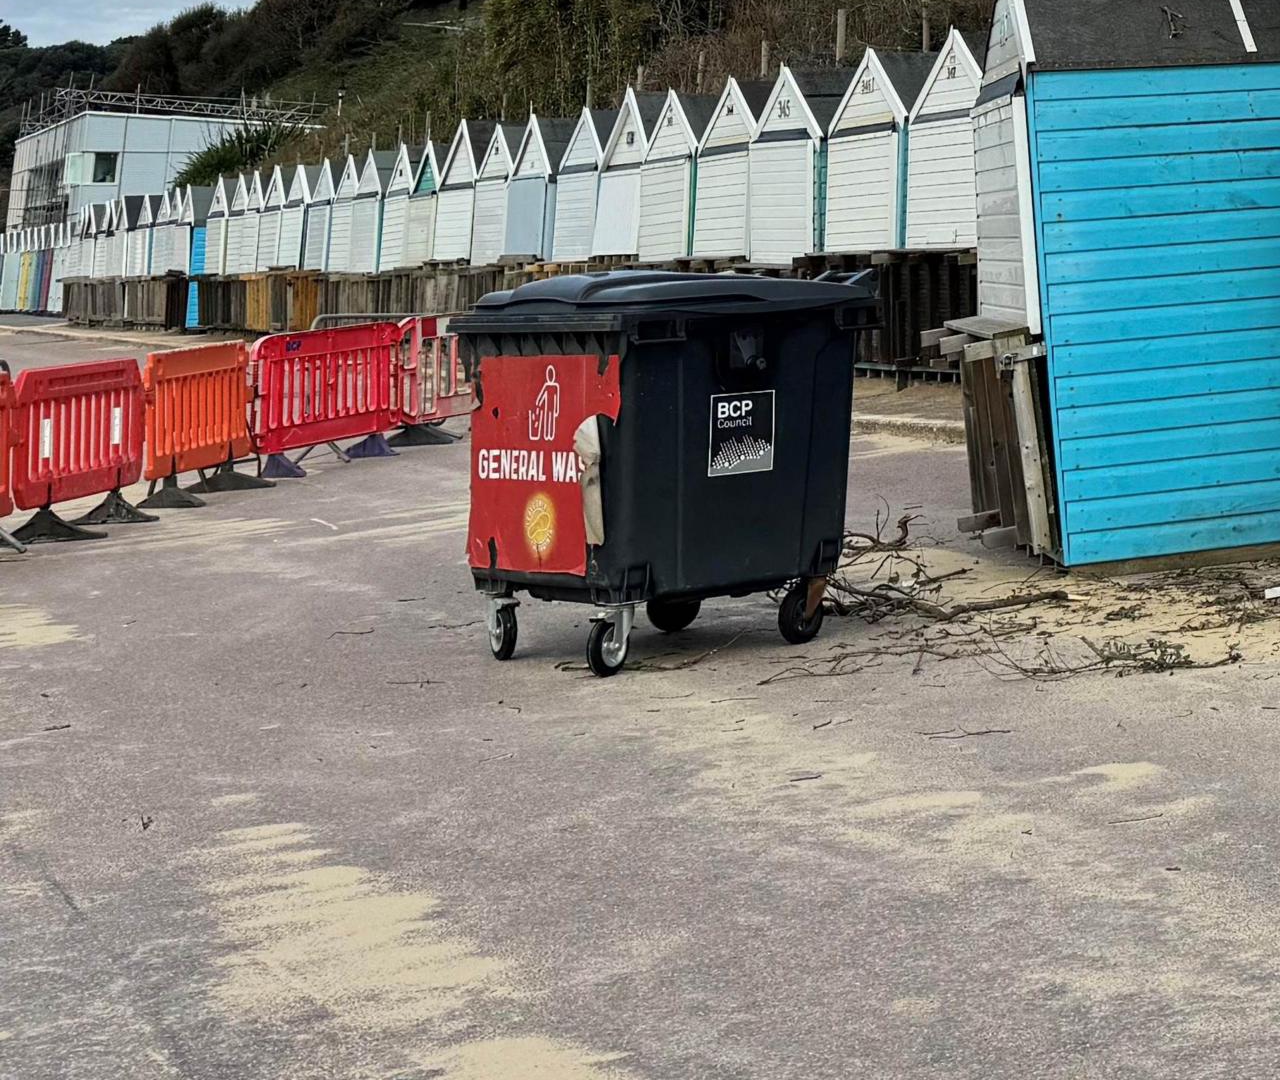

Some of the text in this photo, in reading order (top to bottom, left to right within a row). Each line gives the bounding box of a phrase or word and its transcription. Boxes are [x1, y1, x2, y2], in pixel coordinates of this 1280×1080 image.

[717, 400, 753, 419] BCP
[717, 416, 753, 429] Council
[478, 448, 546, 481] GENERAL
